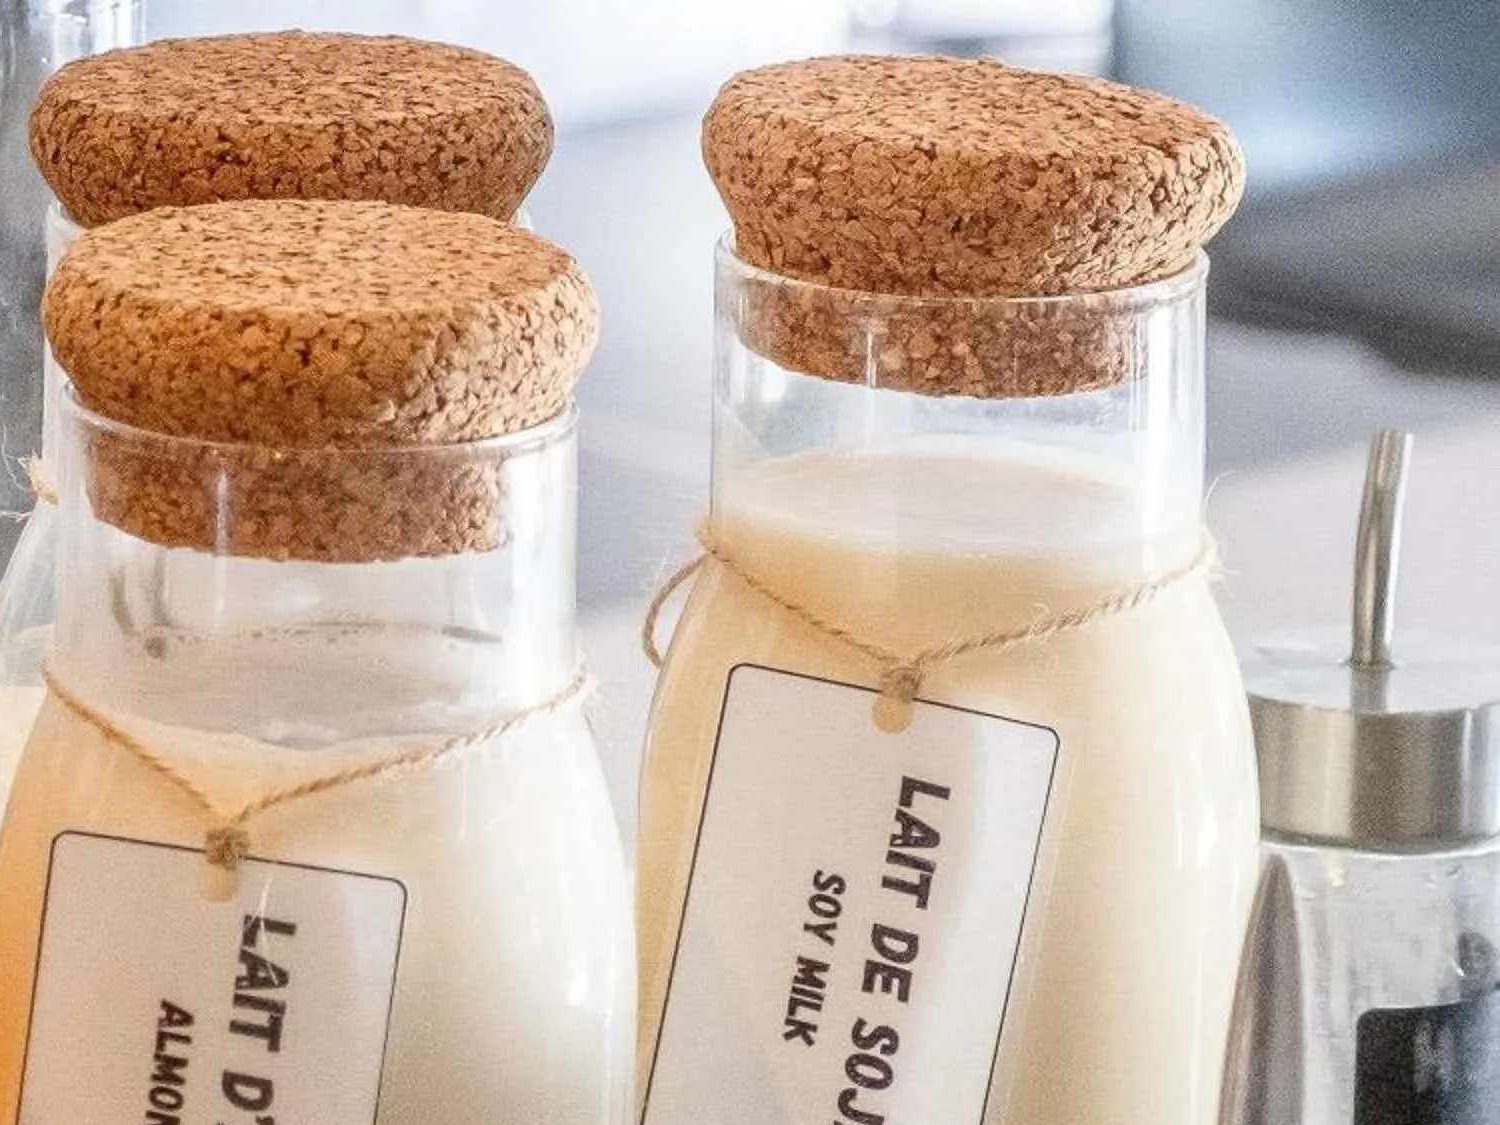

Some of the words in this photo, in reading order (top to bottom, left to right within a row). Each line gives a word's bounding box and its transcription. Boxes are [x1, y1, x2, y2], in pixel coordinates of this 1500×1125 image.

[881, 775, 951, 909] LAIT
[803, 870, 847, 947] SOY
[228, 914, 297, 1053] LAIT
[782, 956, 831, 1047] MILK
[861, 923, 920, 1004] DE
